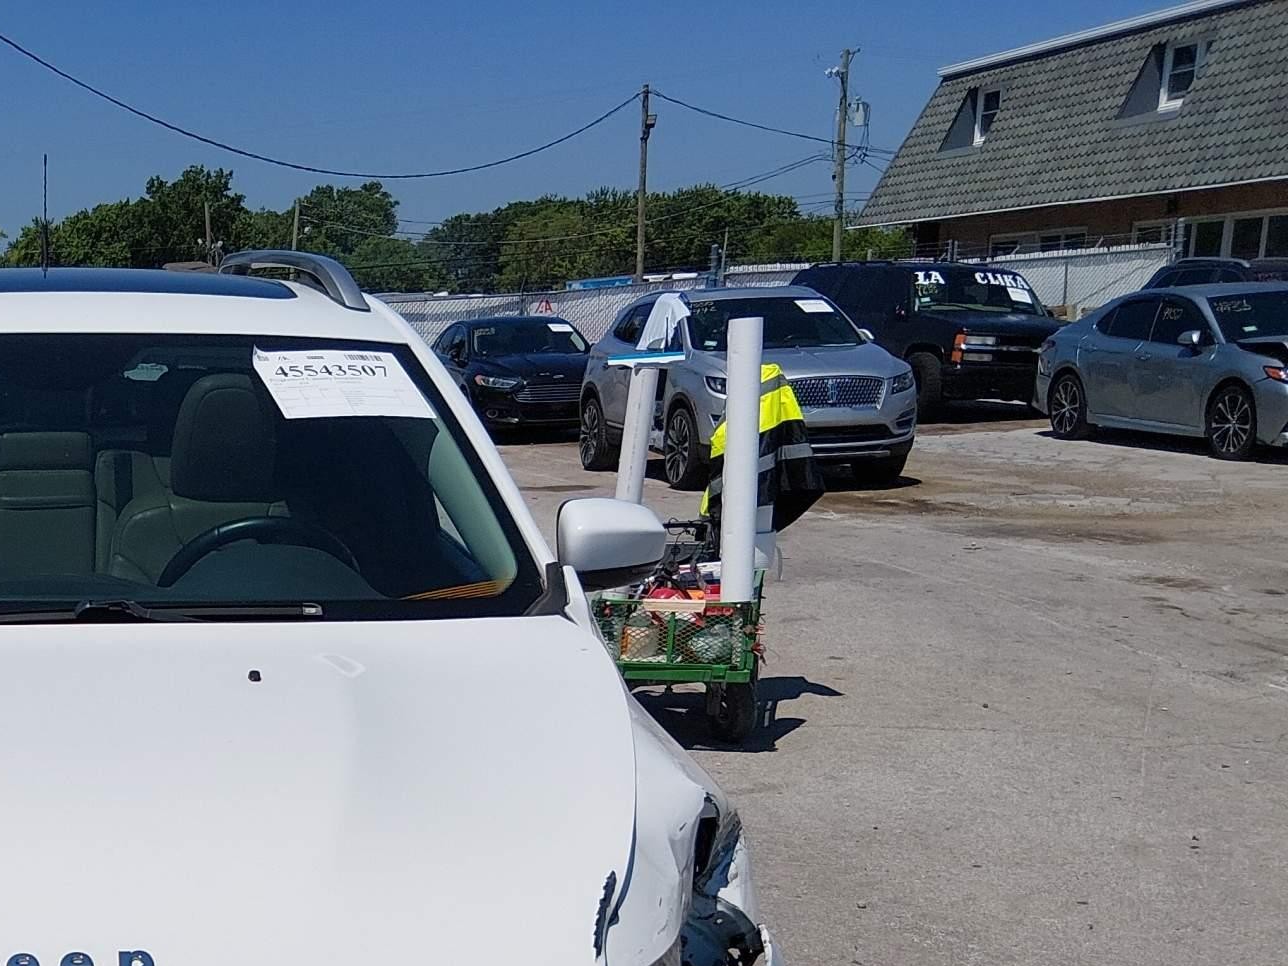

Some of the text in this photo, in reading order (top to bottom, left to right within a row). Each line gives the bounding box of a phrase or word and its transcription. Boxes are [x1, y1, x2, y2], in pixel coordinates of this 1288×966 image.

[914, 271, 1030, 289] LA CLIKA
[275, 364, 388, 378] 45543507
